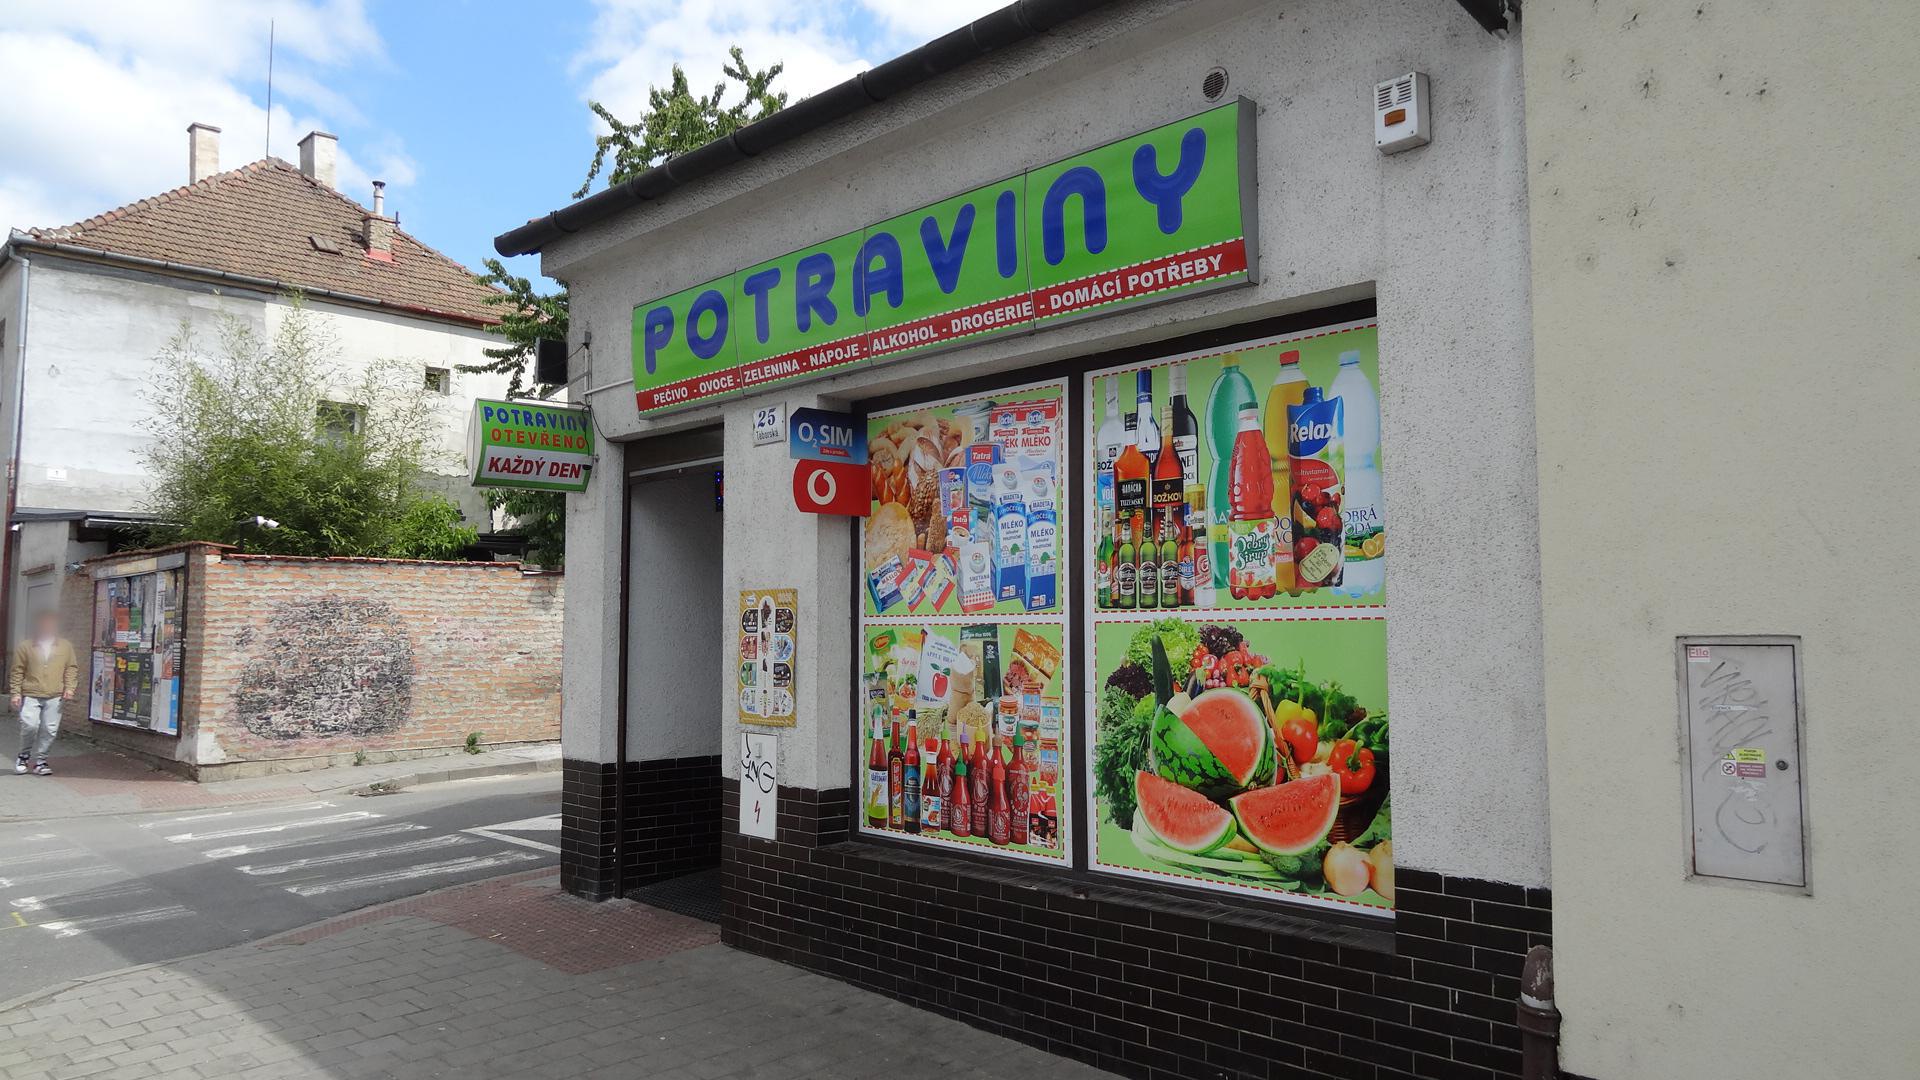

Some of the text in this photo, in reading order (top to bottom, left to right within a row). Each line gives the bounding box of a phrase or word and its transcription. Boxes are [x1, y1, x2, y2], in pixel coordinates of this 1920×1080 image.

[645, 128, 1206, 374] POTRAVINY
[653, 386, 688, 405] PEČIVO
[699, 377, 734, 394] OVOCE
[743, 360, 800, 383] ZELENINA
[809, 343, 860, 367] NÁPOJE
[872, 325, 938, 352] ALKOHOL
[951, 301, 1033, 333] DROGERIE
[1050, 276, 1122, 310] DOMÁCÍ
[1128, 253, 1223, 291] POTŘEBY
[483, 406, 588, 432] POTRAVINY
[757, 407, 777, 429] 25
[491, 428, 586, 449] OTEVŘENO
[820, 424, 853, 447] SIM
[1021, 434, 1051, 448] MLÉKO
[1290, 420, 1336, 443] Relax
[972, 451, 991, 460] Tatra
[488, 455, 583, 479] KAŽDÝ DEN
[1000, 519, 1024, 529] MLÉKO
[1030, 528, 1055, 538] MLÉKO
[1344, 521, 1374, 535] ODA
